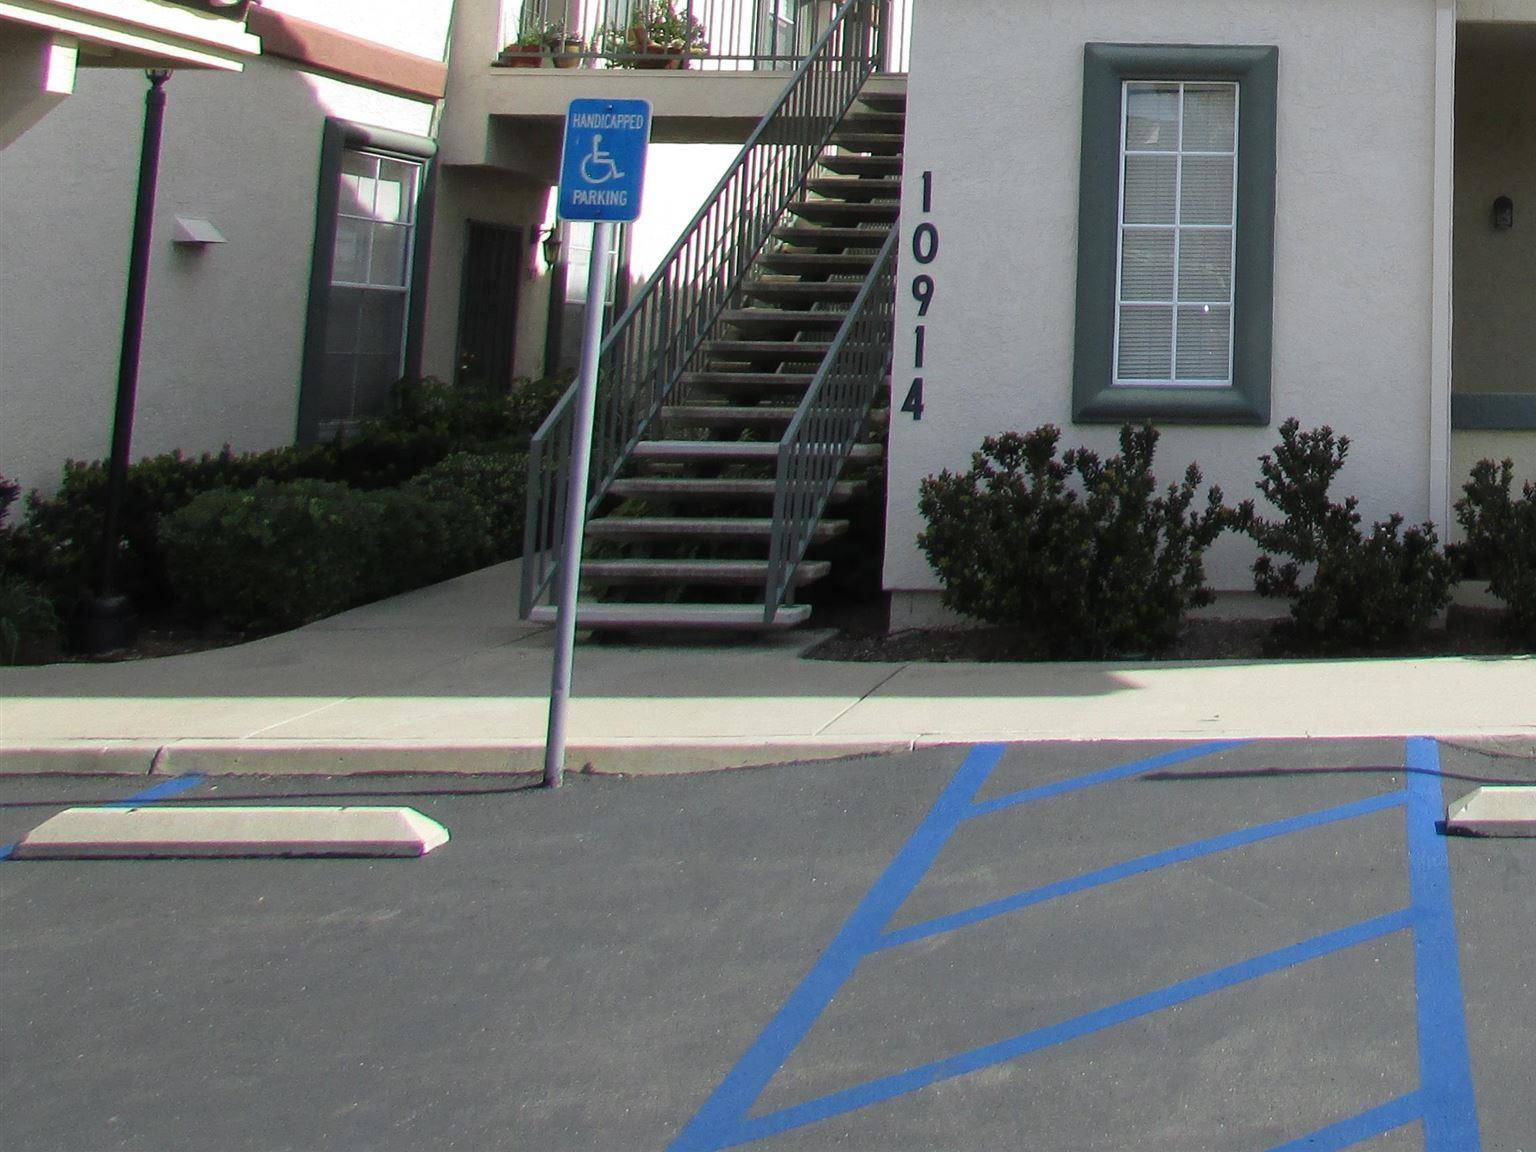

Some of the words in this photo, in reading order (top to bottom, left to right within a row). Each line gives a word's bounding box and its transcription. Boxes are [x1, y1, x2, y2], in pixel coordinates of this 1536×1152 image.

[572, 113, 644, 129] HANDICAPPED
[572, 190, 628, 206] PARKING
[901, 171, 938, 420] 10914
